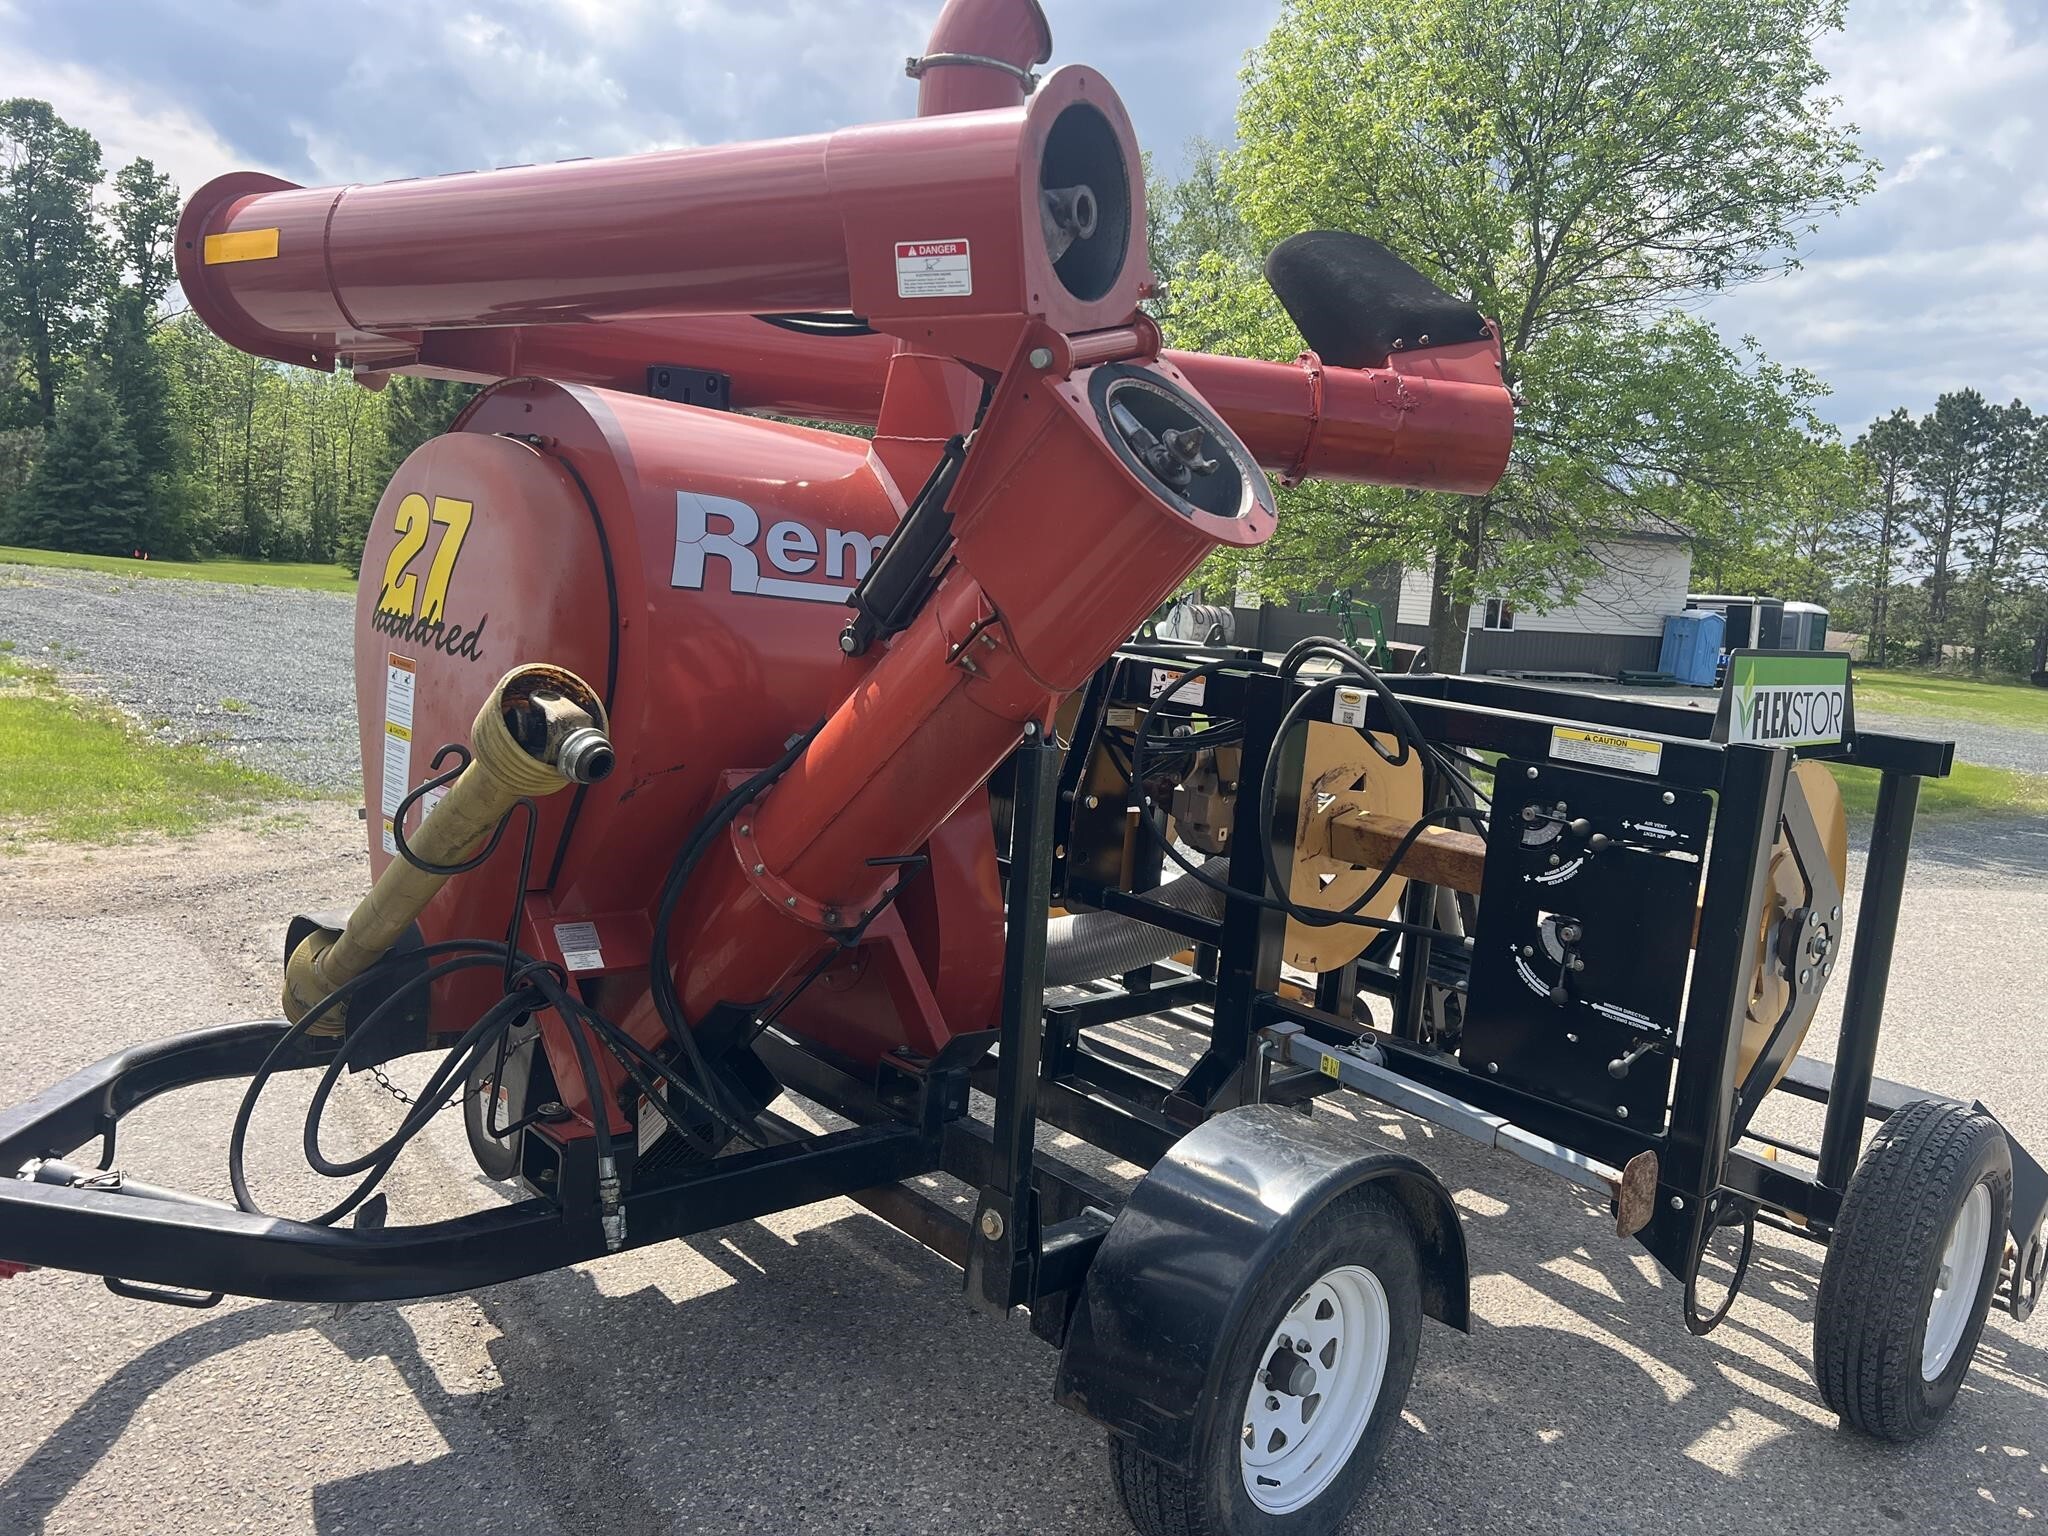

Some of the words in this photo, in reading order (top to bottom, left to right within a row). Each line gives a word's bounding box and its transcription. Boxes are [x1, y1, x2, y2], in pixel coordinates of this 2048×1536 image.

[918, 244, 957, 255] DANGER
[378, 492, 474, 624] 27
[371, 583, 489, 662] hundred
[1751, 691, 1843, 740] FLEXSTOR
[1592, 735, 1628, 747] CAUTION
[1603, 1001, 1623, 1012] WINDER
[1623, 1008, 1650, 1021] DIRECTION
